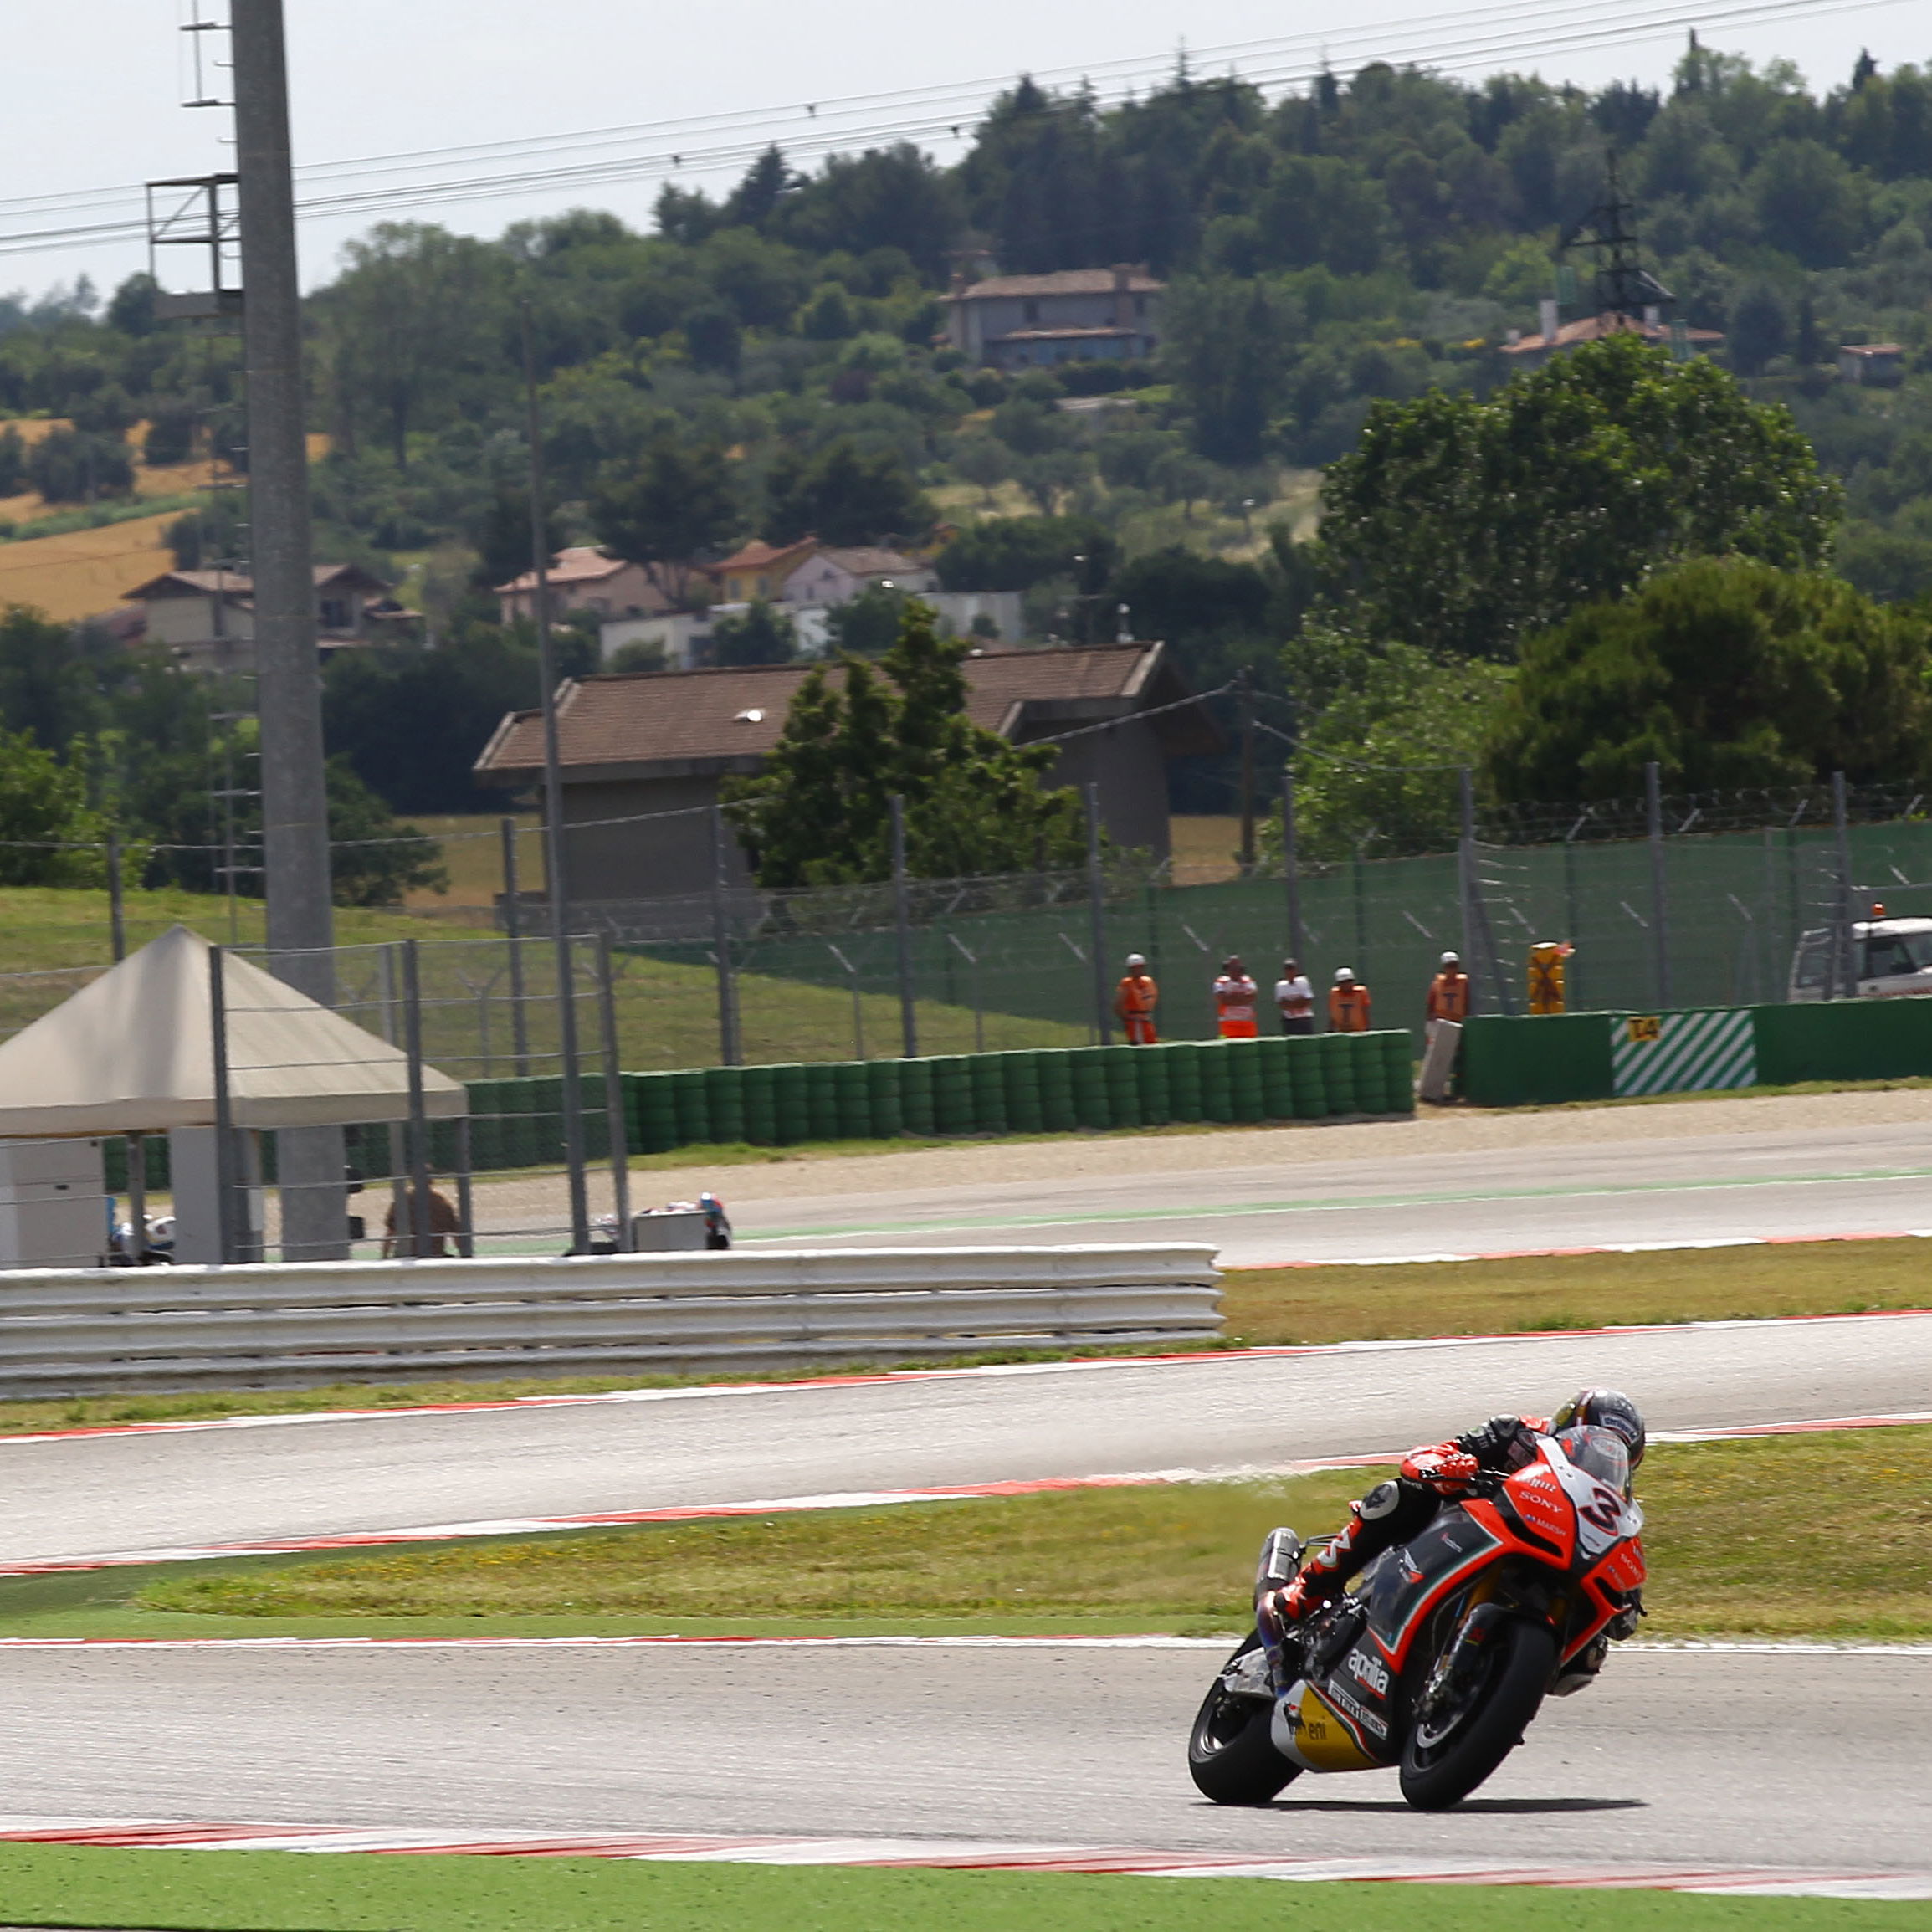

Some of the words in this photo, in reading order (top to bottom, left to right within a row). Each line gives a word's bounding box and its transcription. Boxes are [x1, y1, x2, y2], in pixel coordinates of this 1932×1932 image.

[1519, 1490, 1564, 1514] SONY
[1578, 1487, 1622, 1537] 3
[1348, 1648, 1389, 1696] aprilia
[1309, 1715, 1327, 1740] eni
